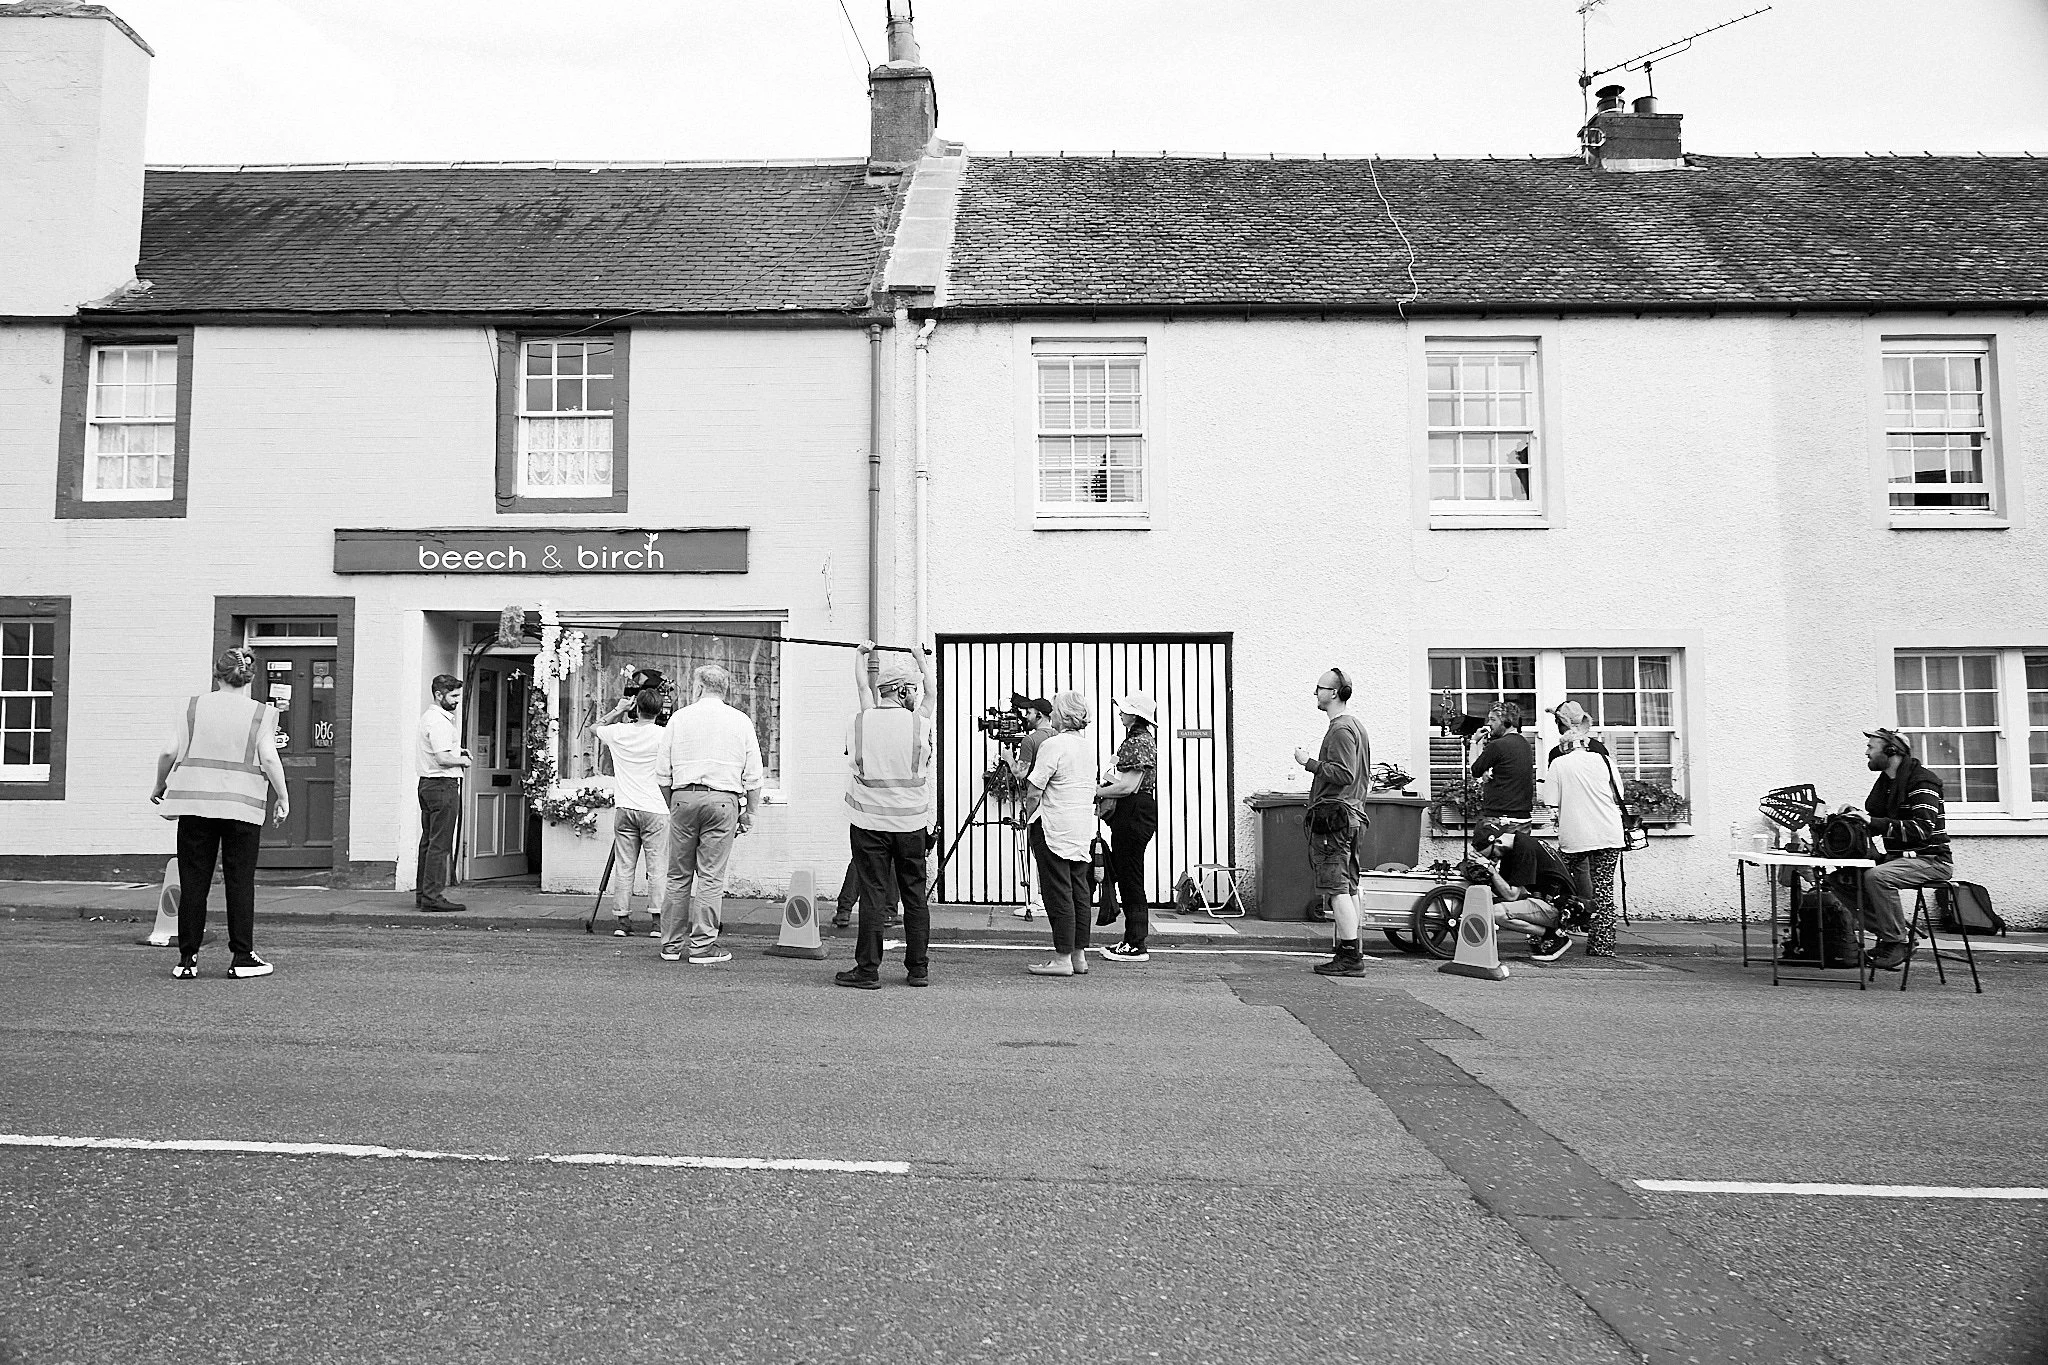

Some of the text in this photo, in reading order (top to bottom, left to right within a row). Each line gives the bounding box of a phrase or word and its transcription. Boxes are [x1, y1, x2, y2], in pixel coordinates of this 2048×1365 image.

[419, 535, 664, 569] beech & birch
[315, 721, 334, 740] DOG
